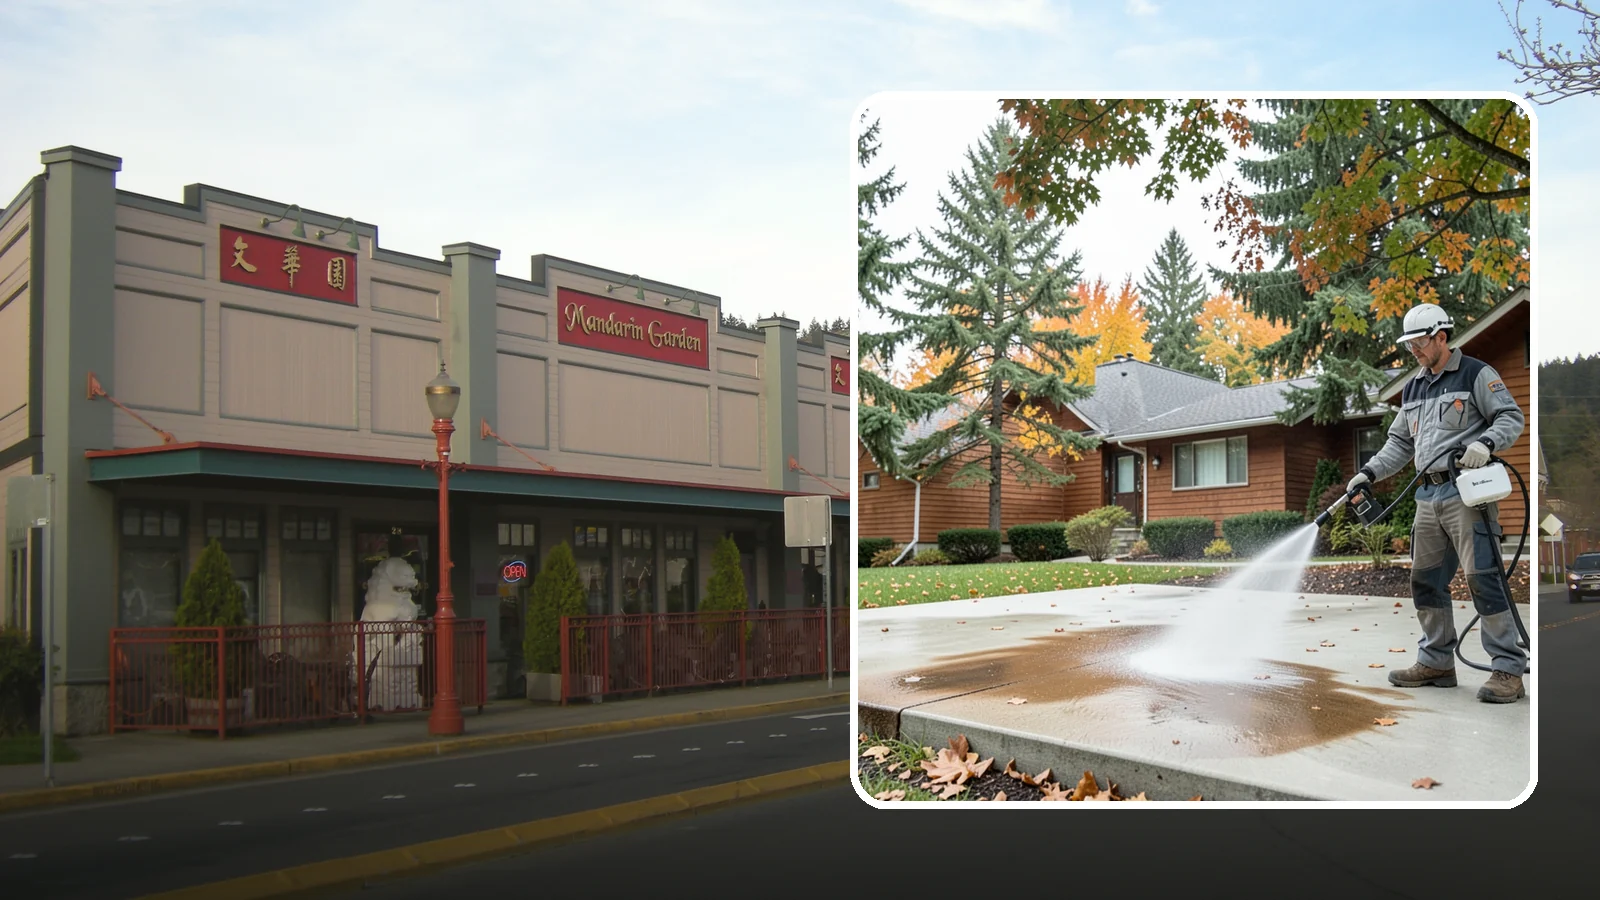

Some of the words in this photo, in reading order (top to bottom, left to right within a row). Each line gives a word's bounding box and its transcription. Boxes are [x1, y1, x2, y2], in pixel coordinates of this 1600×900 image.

[231, 235, 346, 291] 文華園
[564, 302, 644, 341] Mandarin
[648, 320, 702, 352] Garden
[503, 565, 527, 578] OPEN
